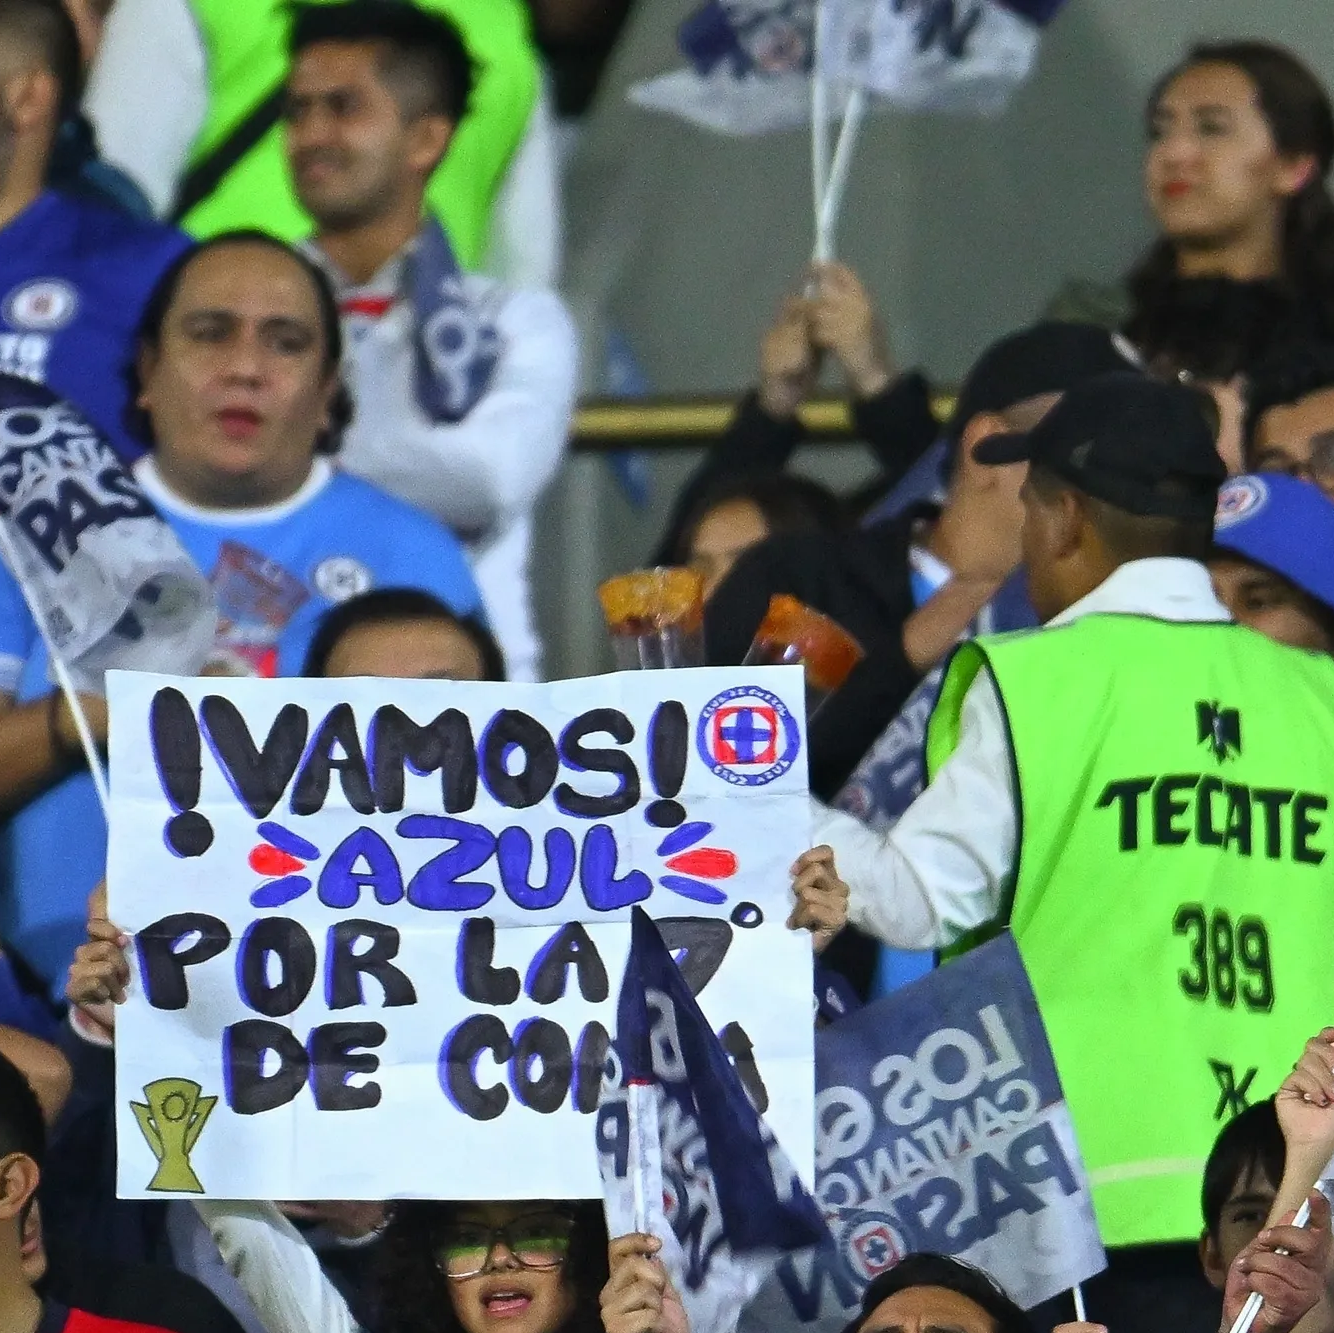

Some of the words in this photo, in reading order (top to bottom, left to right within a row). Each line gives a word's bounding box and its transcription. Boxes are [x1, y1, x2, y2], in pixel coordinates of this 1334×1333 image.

[16, 470, 157, 575] PAS
[318, 814, 654, 912] AZUL
[1094, 772, 1329, 866] TECATE
[134, 912, 418, 1018] POR
[456, 916, 610, 1005] LA
[1173, 901, 1276, 1015] 389
[223, 1018, 388, 1116] DE
